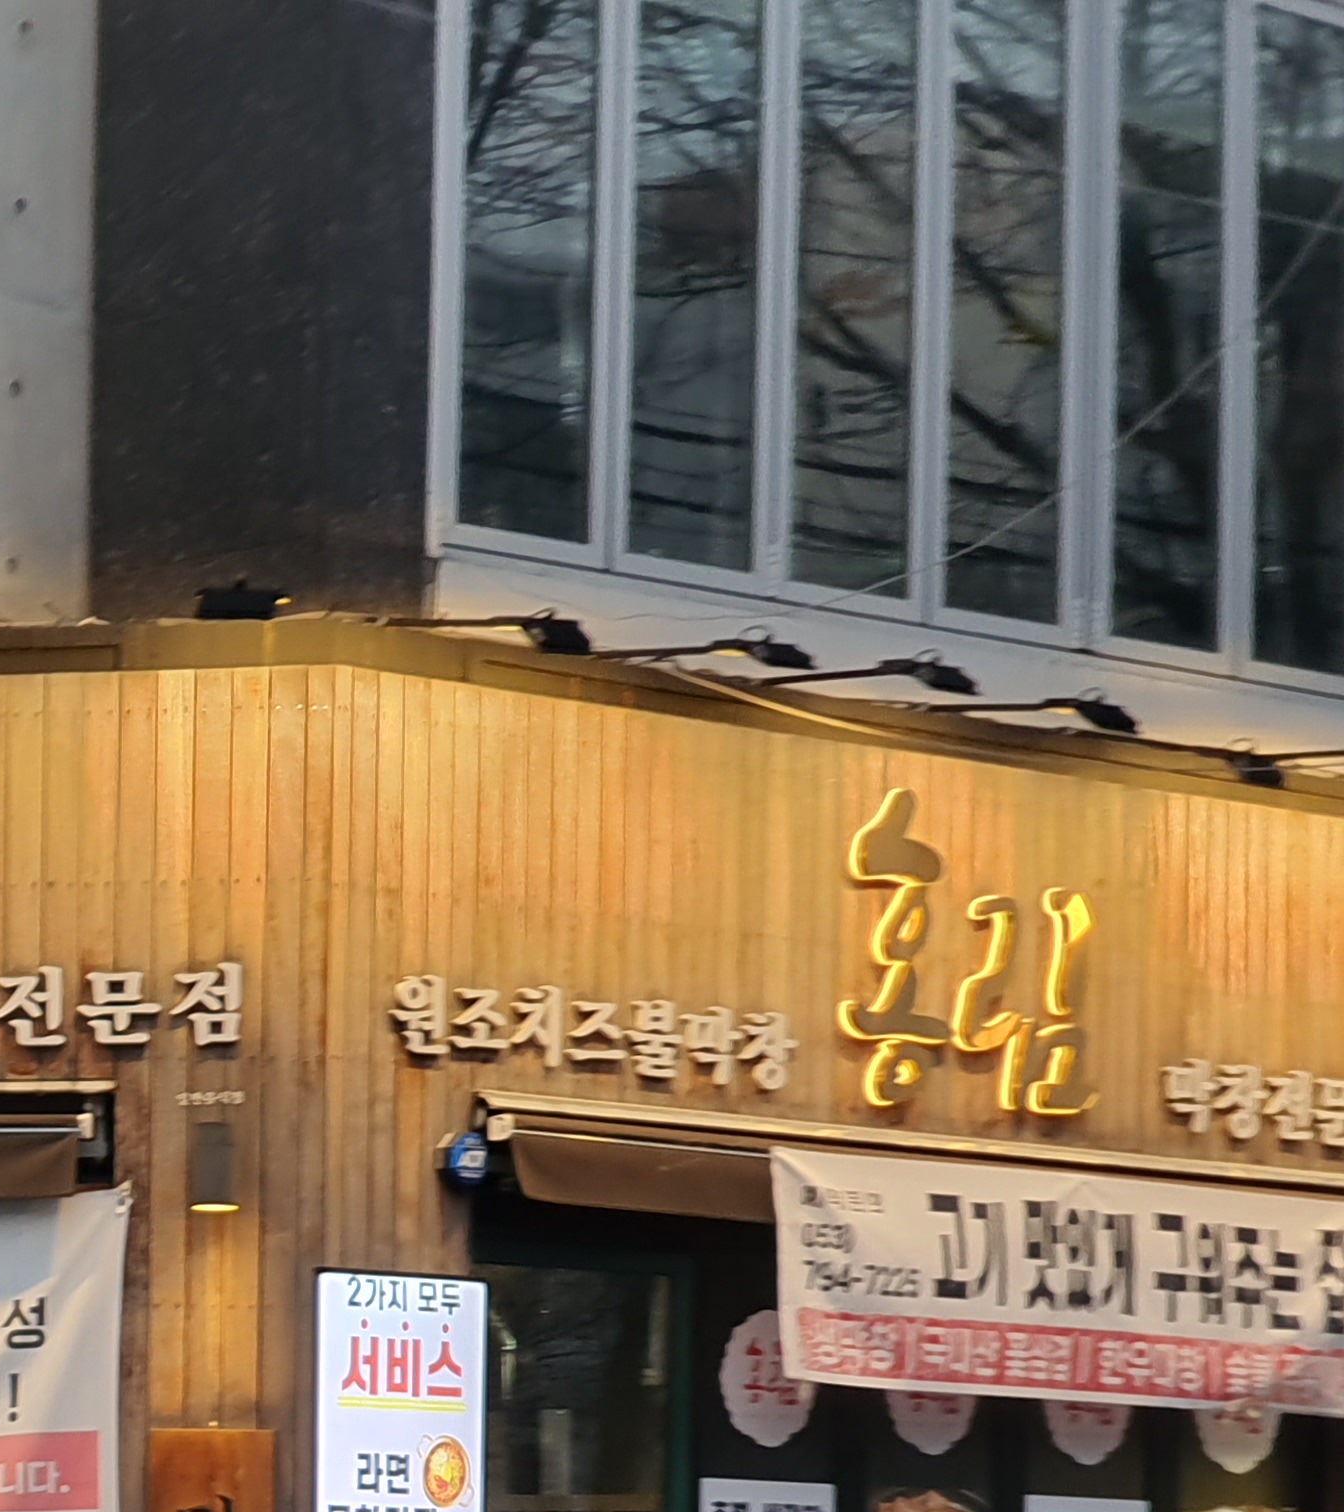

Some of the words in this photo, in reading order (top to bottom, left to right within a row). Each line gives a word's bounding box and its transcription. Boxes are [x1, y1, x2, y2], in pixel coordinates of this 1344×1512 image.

[838, 787, 1098, 1115] 홍림
[389, 974, 798, 1091] 원조치즈불막창
[346, 1276, 410, 1316] 2가지
[415, 1282, 461, 1317] 모두
[925, 1192, 1008, 1306] 고기
[1021, 1199, 1137, 1317] 맛있게
[1152, 1212, 1303, 1331] 구워주는
[341, 1333, 464, 1399] 서비스
[356, 1452, 411, 1497] 라면
